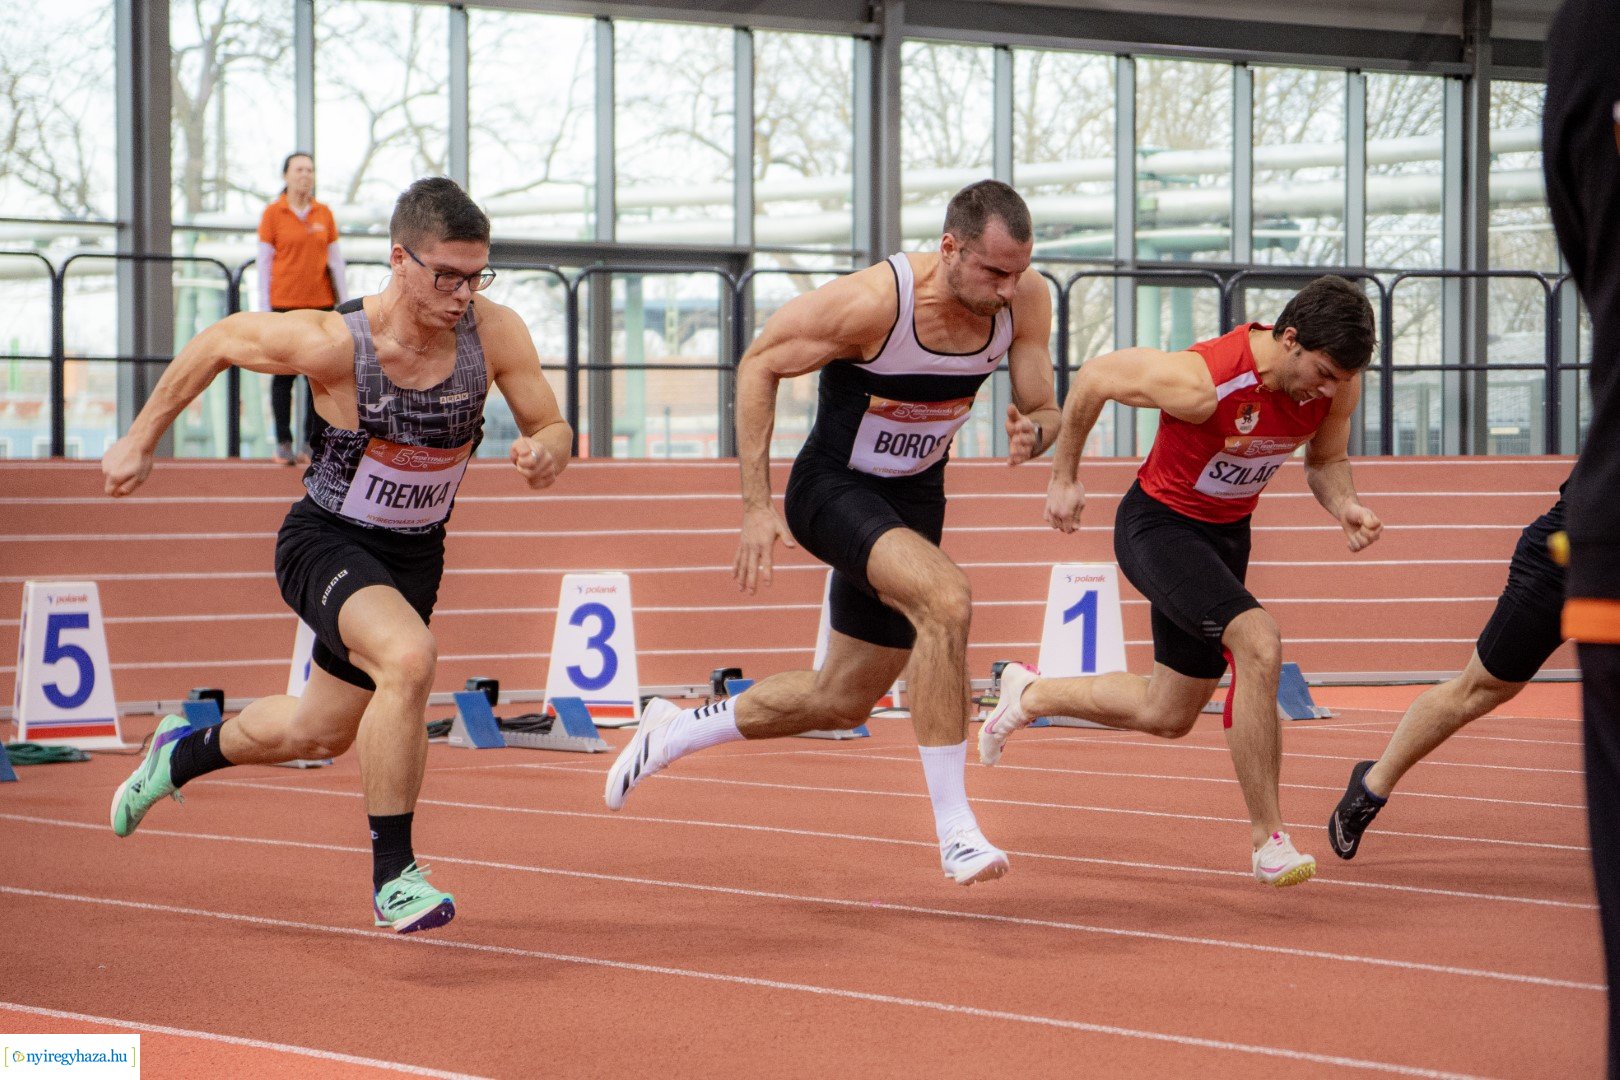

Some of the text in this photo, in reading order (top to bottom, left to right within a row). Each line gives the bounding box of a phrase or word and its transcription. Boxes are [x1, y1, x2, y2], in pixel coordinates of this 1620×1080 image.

[365, 474, 451, 509] TRENKA
[585, 584, 617, 595] polanik
[1074, 574, 1106, 584] polanik
[41, 612, 95, 710] 5
[566, 602, 618, 691] 3
[1063, 590, 1098, 673] 1
